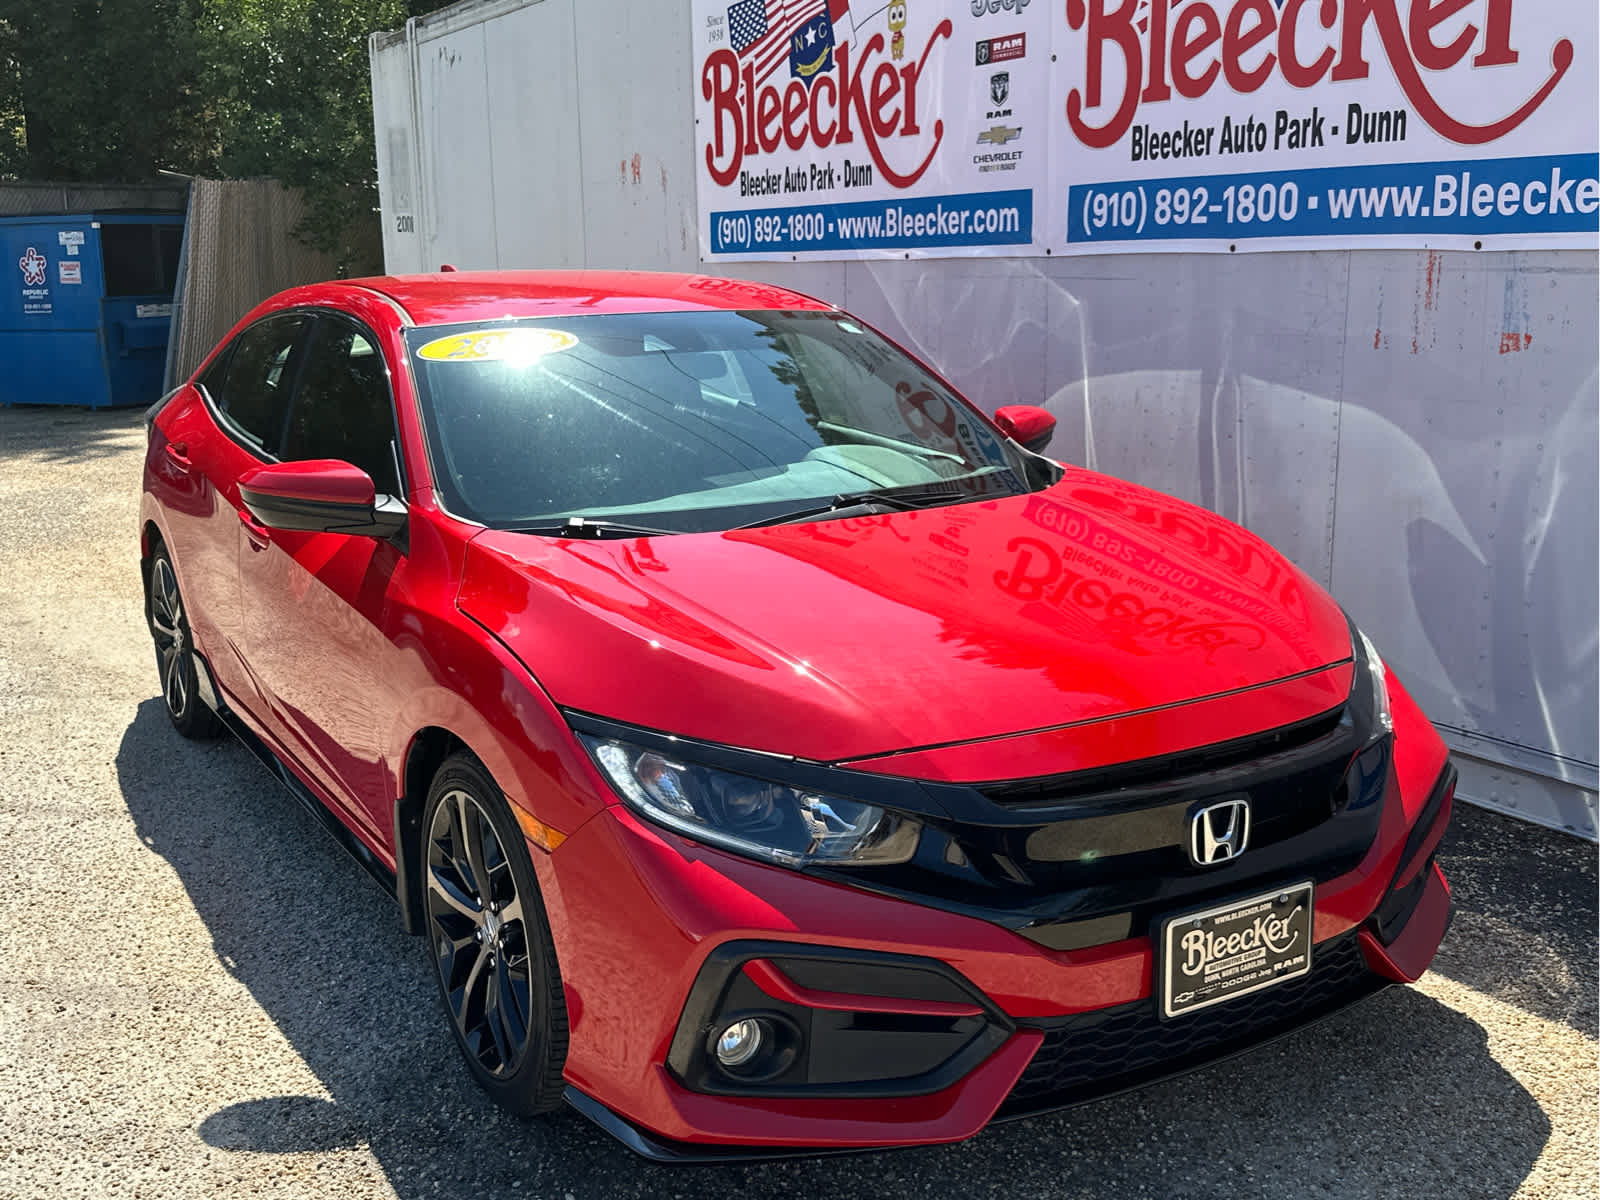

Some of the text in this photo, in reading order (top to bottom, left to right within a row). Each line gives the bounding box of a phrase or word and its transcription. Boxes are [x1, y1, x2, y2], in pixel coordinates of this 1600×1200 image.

[993, 38, 1023, 51] RAM
[702, 19, 953, 189] Bleecker
[986, 109, 1012, 119] RAM
[1131, 103, 1407, 161] Bleecker Auto Park Dunn
[740, 160, 872, 196] Bleecker Auto Park Dunn
[973, 151, 1024, 164] CHEVROLET
[718, 203, 1020, 249] (910) 892-1800 www.Bleecker.com
[1082, 186, 1147, 236] (910)
[1154, 182, 1298, 226] 892-1800
[1181, 905, 1302, 976] Bleecker
[1273, 955, 1305, 971] RAM
